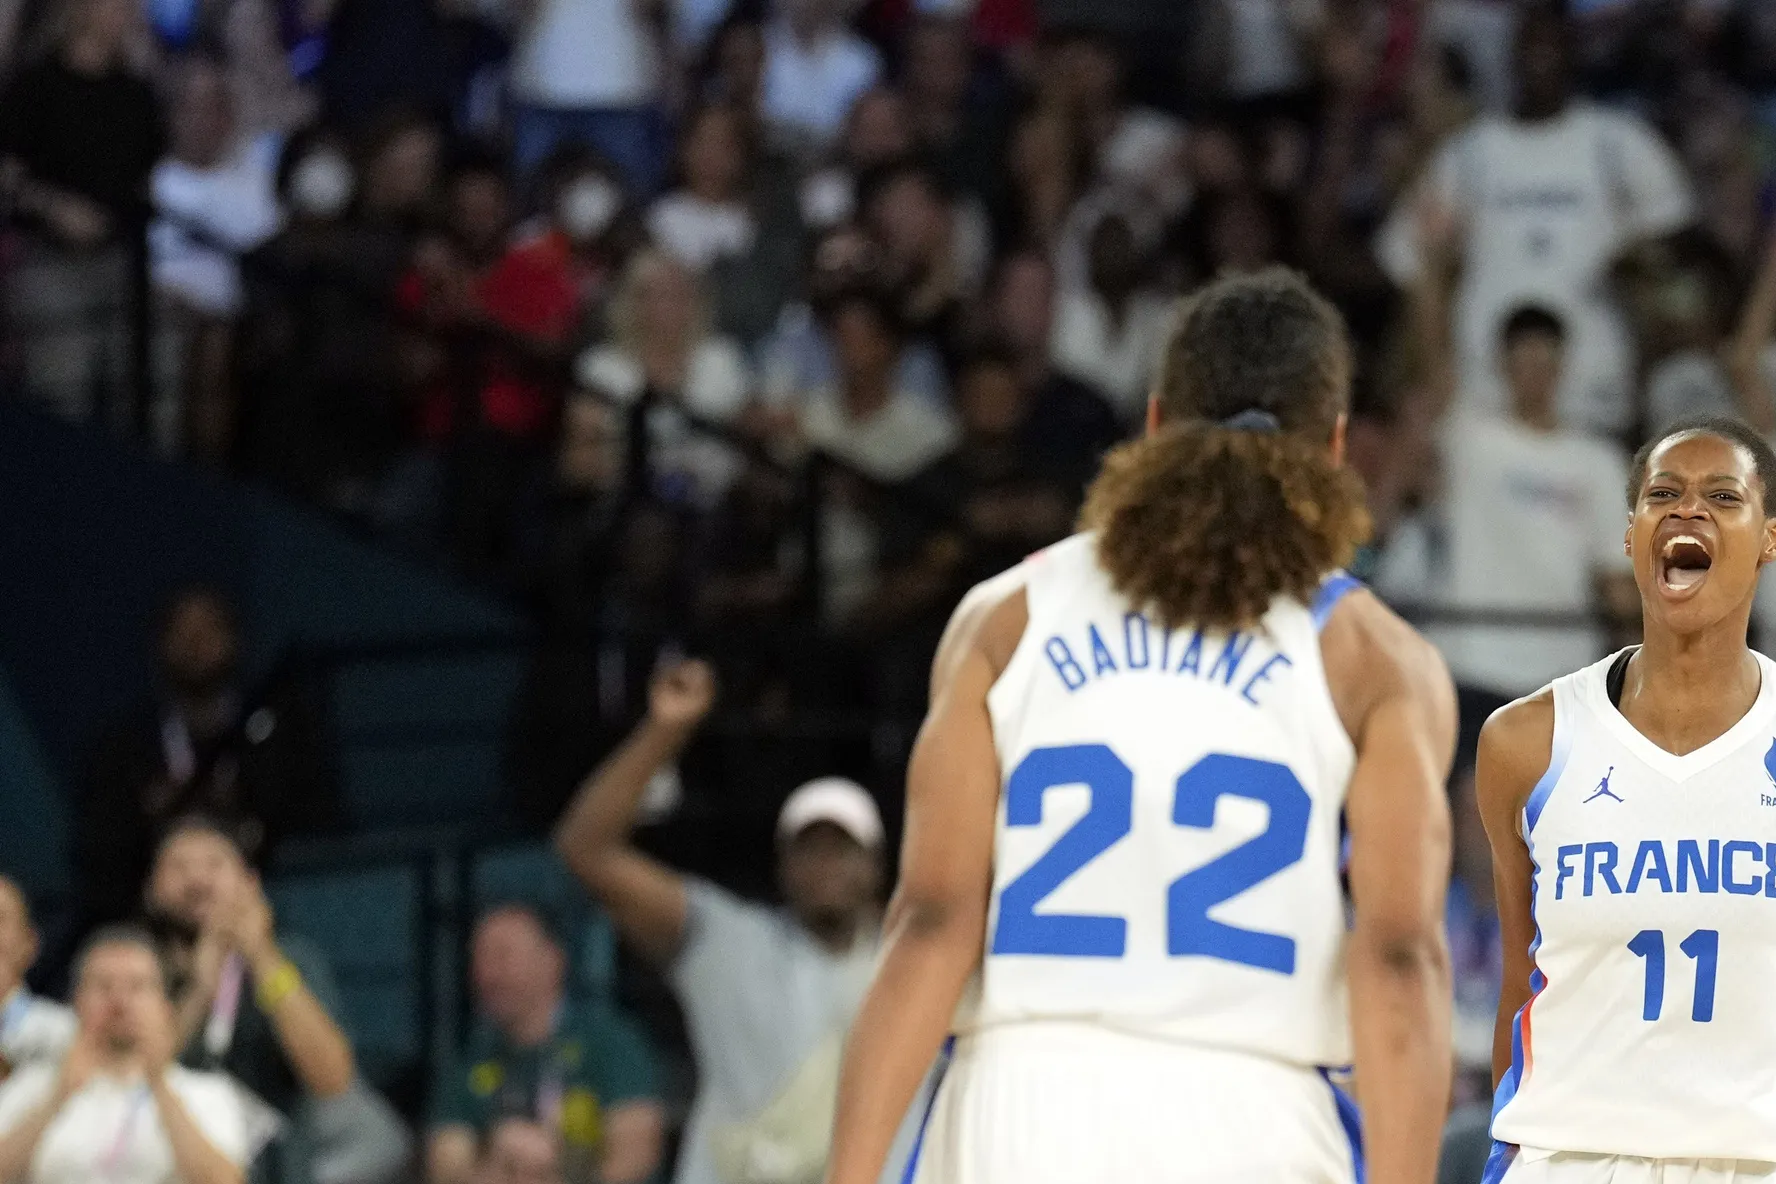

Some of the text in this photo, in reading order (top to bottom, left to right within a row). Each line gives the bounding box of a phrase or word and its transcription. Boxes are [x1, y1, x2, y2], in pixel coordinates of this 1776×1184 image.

[1044, 610, 1292, 707] BADIANE
[992, 744, 1311, 976] 22
[1626, 929, 1719, 1022] 11
